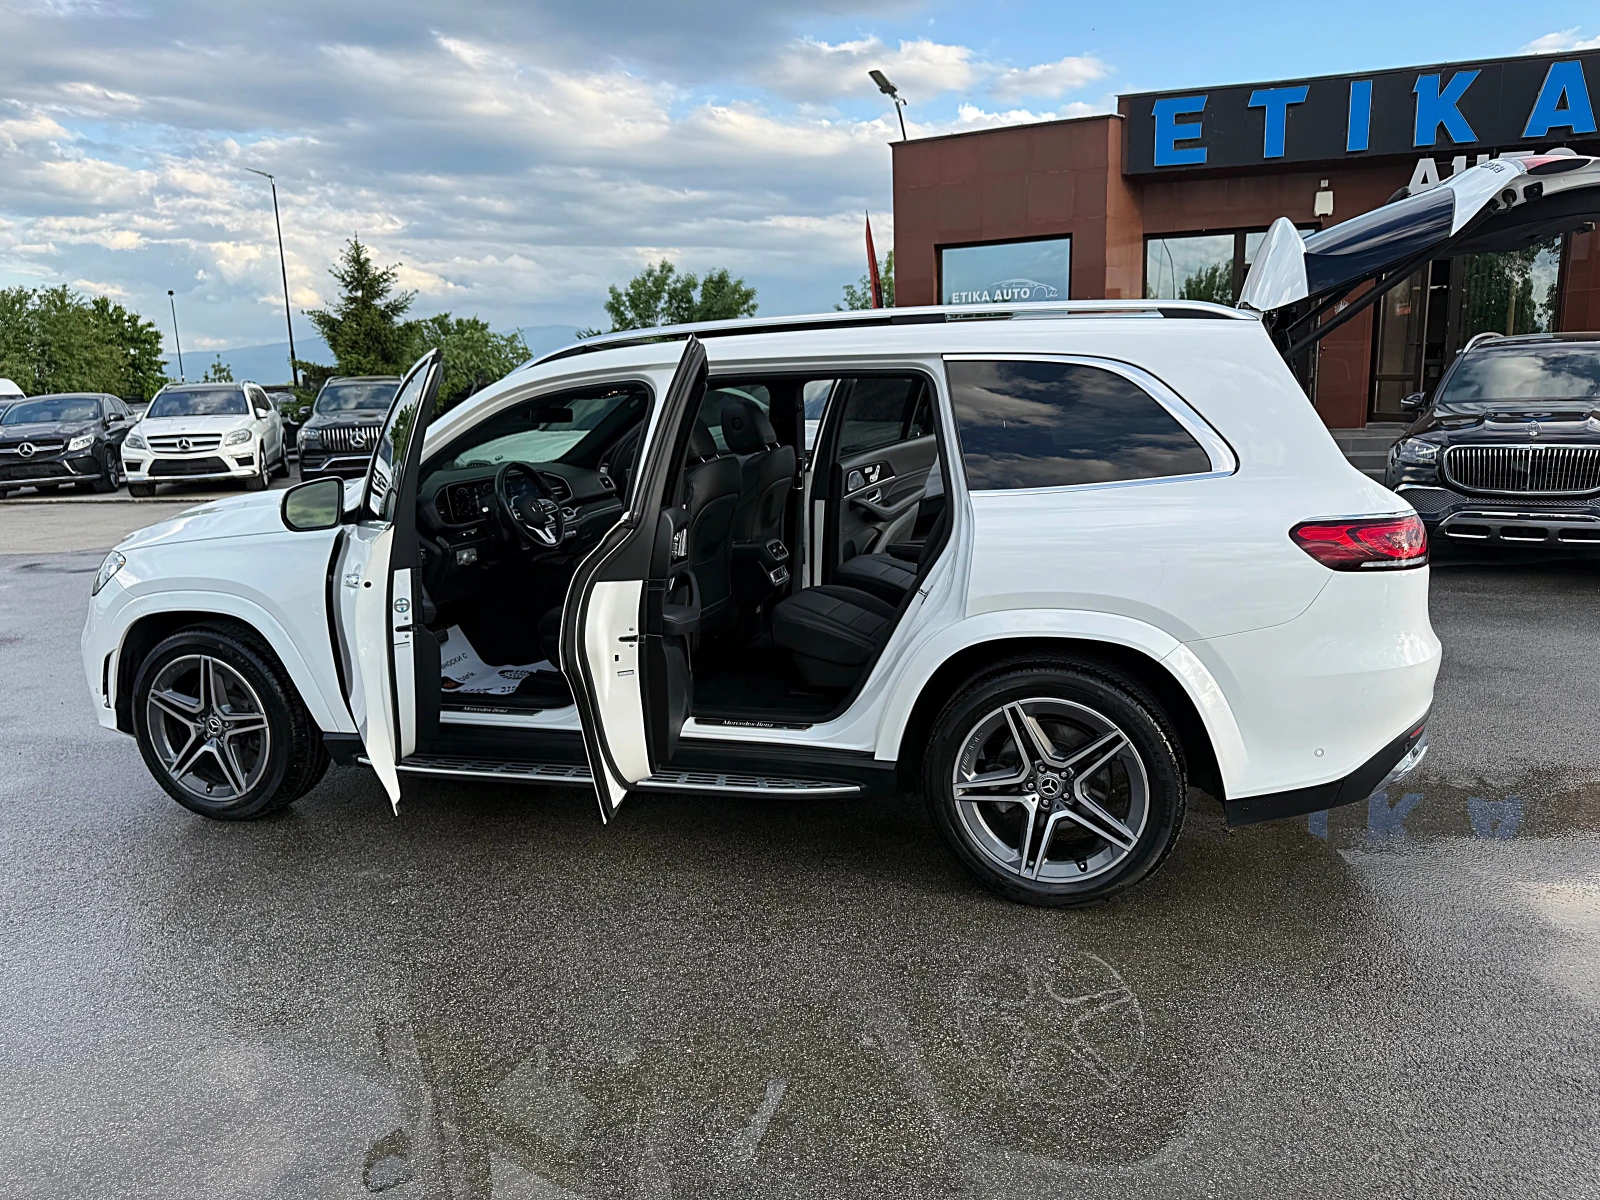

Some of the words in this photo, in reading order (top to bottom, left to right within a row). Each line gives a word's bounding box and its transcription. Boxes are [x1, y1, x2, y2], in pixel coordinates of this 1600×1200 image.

[1152, 60, 1598, 166] ETIKA
[951, 290, 990, 304] ETIKA
[993, 287, 1031, 301] AUTO
[722, 720, 774, 728] Mercedes-Benz
